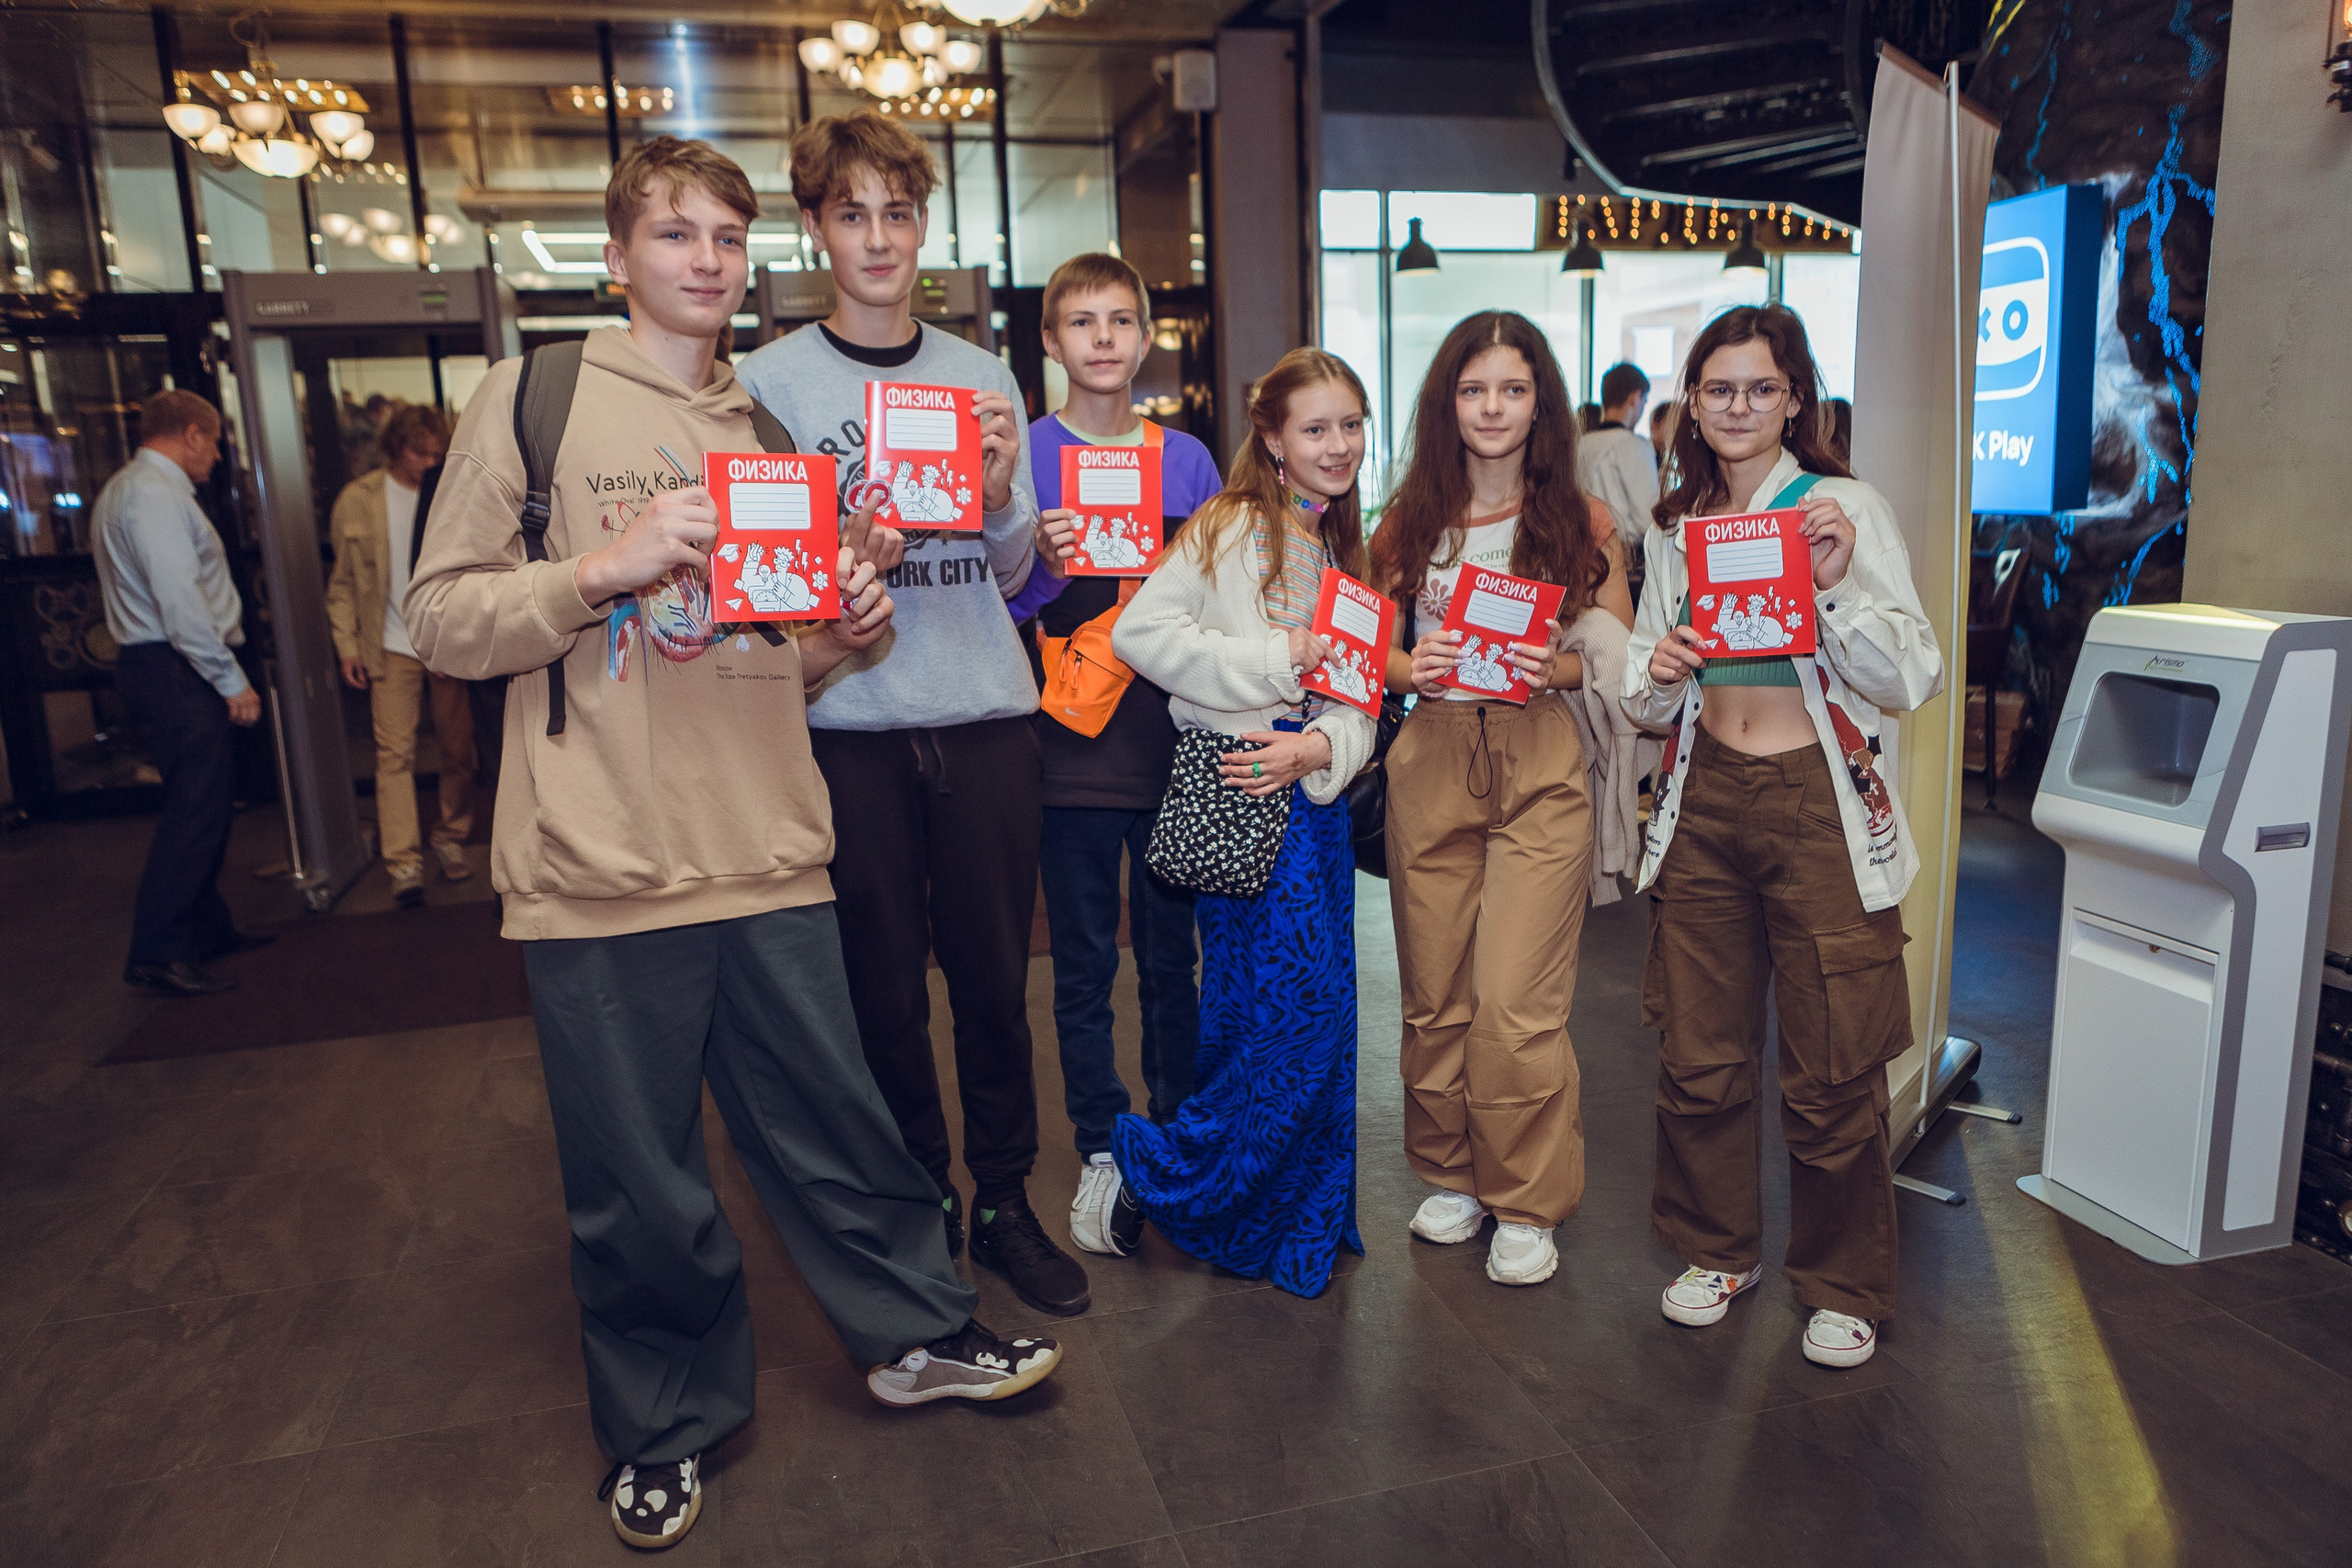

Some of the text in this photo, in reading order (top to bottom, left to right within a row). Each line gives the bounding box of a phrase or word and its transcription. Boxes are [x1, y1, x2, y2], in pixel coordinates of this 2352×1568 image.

[886, 386, 956, 410] ФИЗИКА
[1078, 449, 1139, 468] ФИЗИКА
[1973, 429, 2034, 467] K Play
[728, 457, 808, 481] ФИЗИКА
[586, 470, 704, 494] Vasily Kandi
[1705, 516, 1781, 543] ФИЗИКА
[877, 556, 989, 589] ORK CITY
[1338, 577, 1381, 614] ФИЗИКА
[1476, 572, 1538, 603] ФИЗИКА
[737, 673, 766, 682] Tretyakov
[768, 673, 791, 682] Gallery
